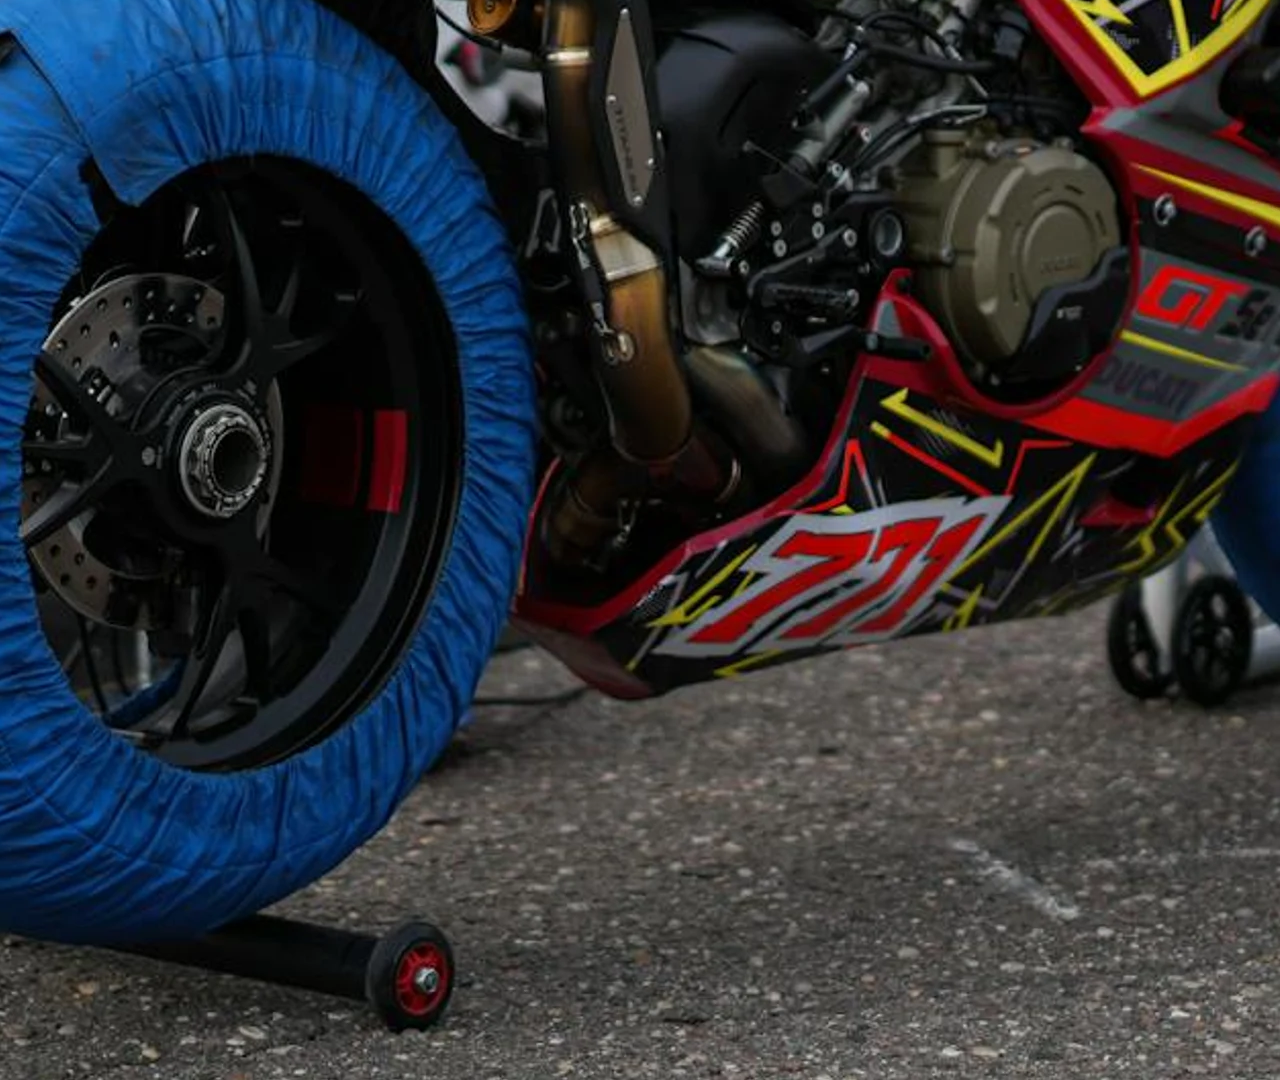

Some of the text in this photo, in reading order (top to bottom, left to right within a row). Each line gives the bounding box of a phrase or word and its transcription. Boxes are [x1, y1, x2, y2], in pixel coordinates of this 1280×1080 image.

[1135, 265, 1253, 331] GT
[1098, 354, 1204, 416] DUCATI
[684, 514, 987, 645] 771
